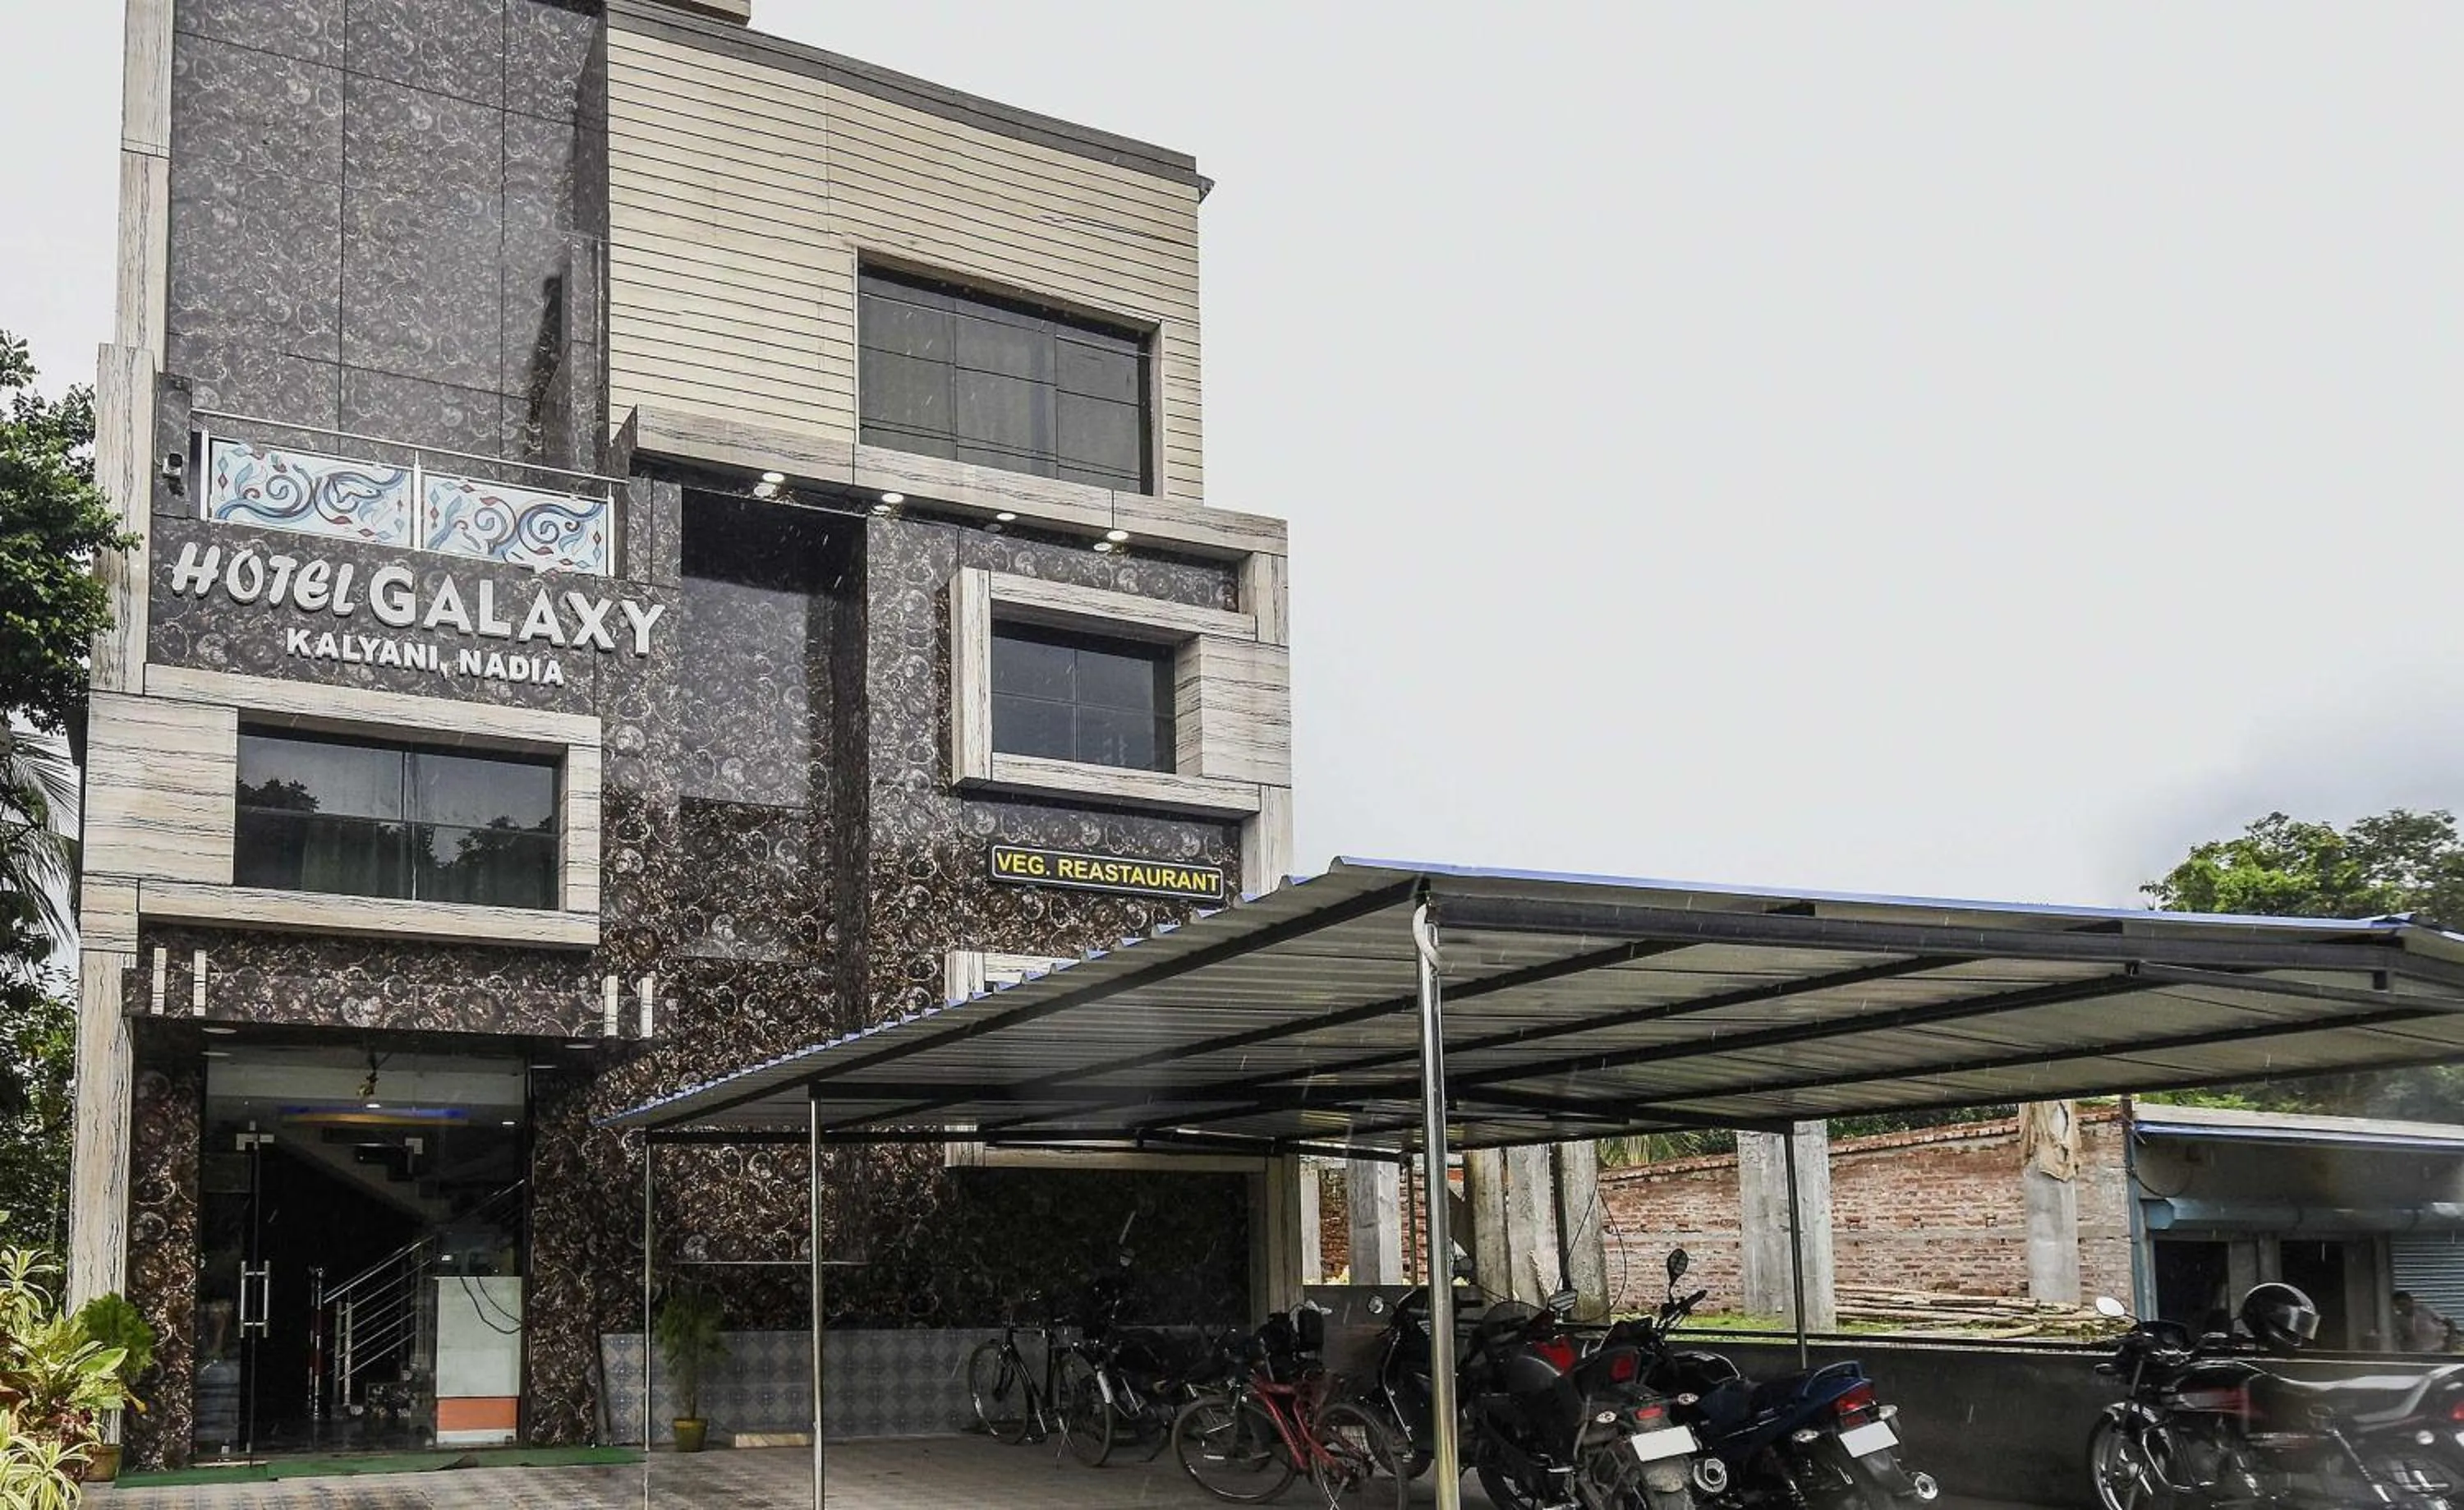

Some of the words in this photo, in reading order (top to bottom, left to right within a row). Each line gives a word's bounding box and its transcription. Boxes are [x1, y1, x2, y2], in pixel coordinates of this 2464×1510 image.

[369, 566, 666, 656] GALAXY
[286, 628, 449, 679] KALYANI,
[457, 651, 565, 687] NADIA
[995, 852, 1051, 877] VEG.
[1058, 859, 1220, 891] REASTAURANT
